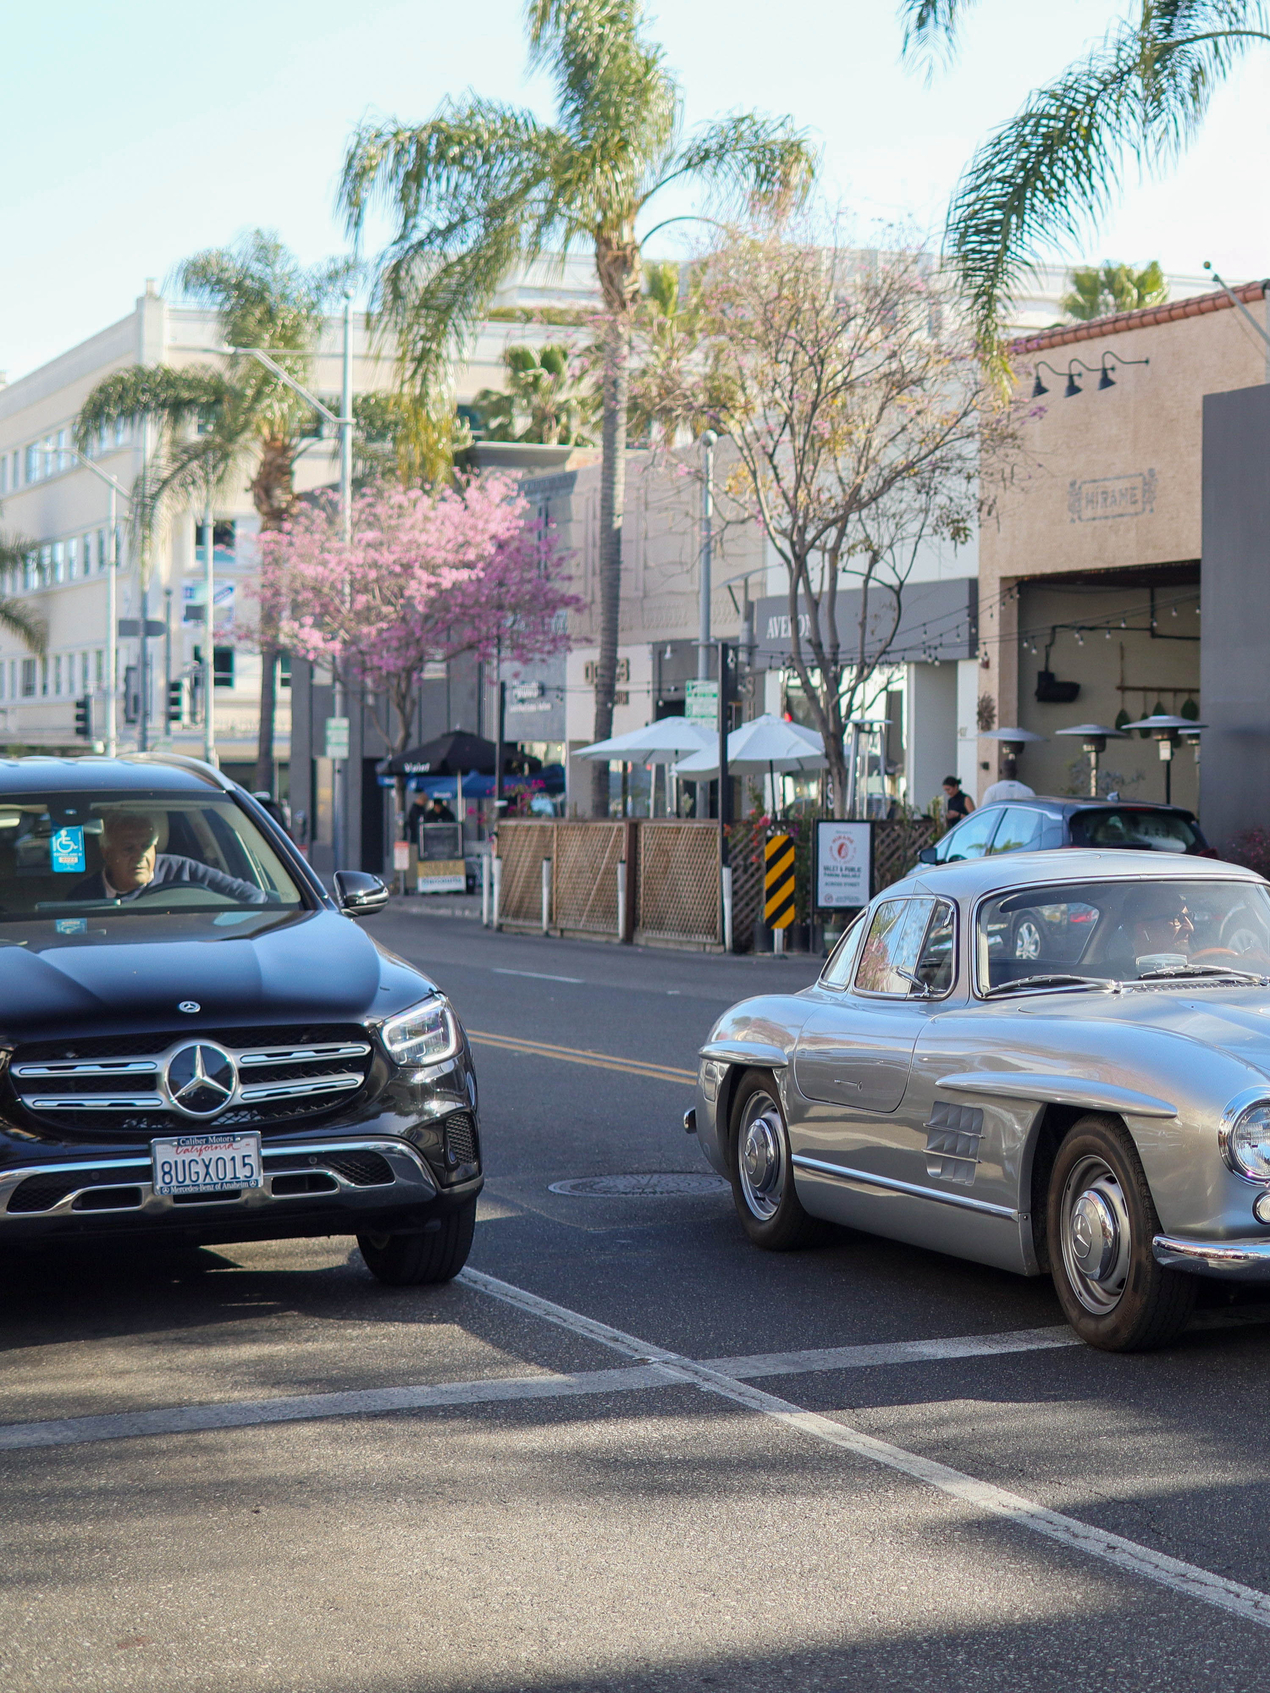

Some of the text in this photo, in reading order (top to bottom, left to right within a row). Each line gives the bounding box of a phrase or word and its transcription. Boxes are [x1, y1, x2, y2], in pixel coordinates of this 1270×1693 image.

[179, 1135, 234, 1146] Caliber Motors
[175, 1143, 240, 1157] California
[161, 1154, 255, 1185] 8UGX015
[170, 1180, 249, 1194] Mercedes-Benz of Anaheim
